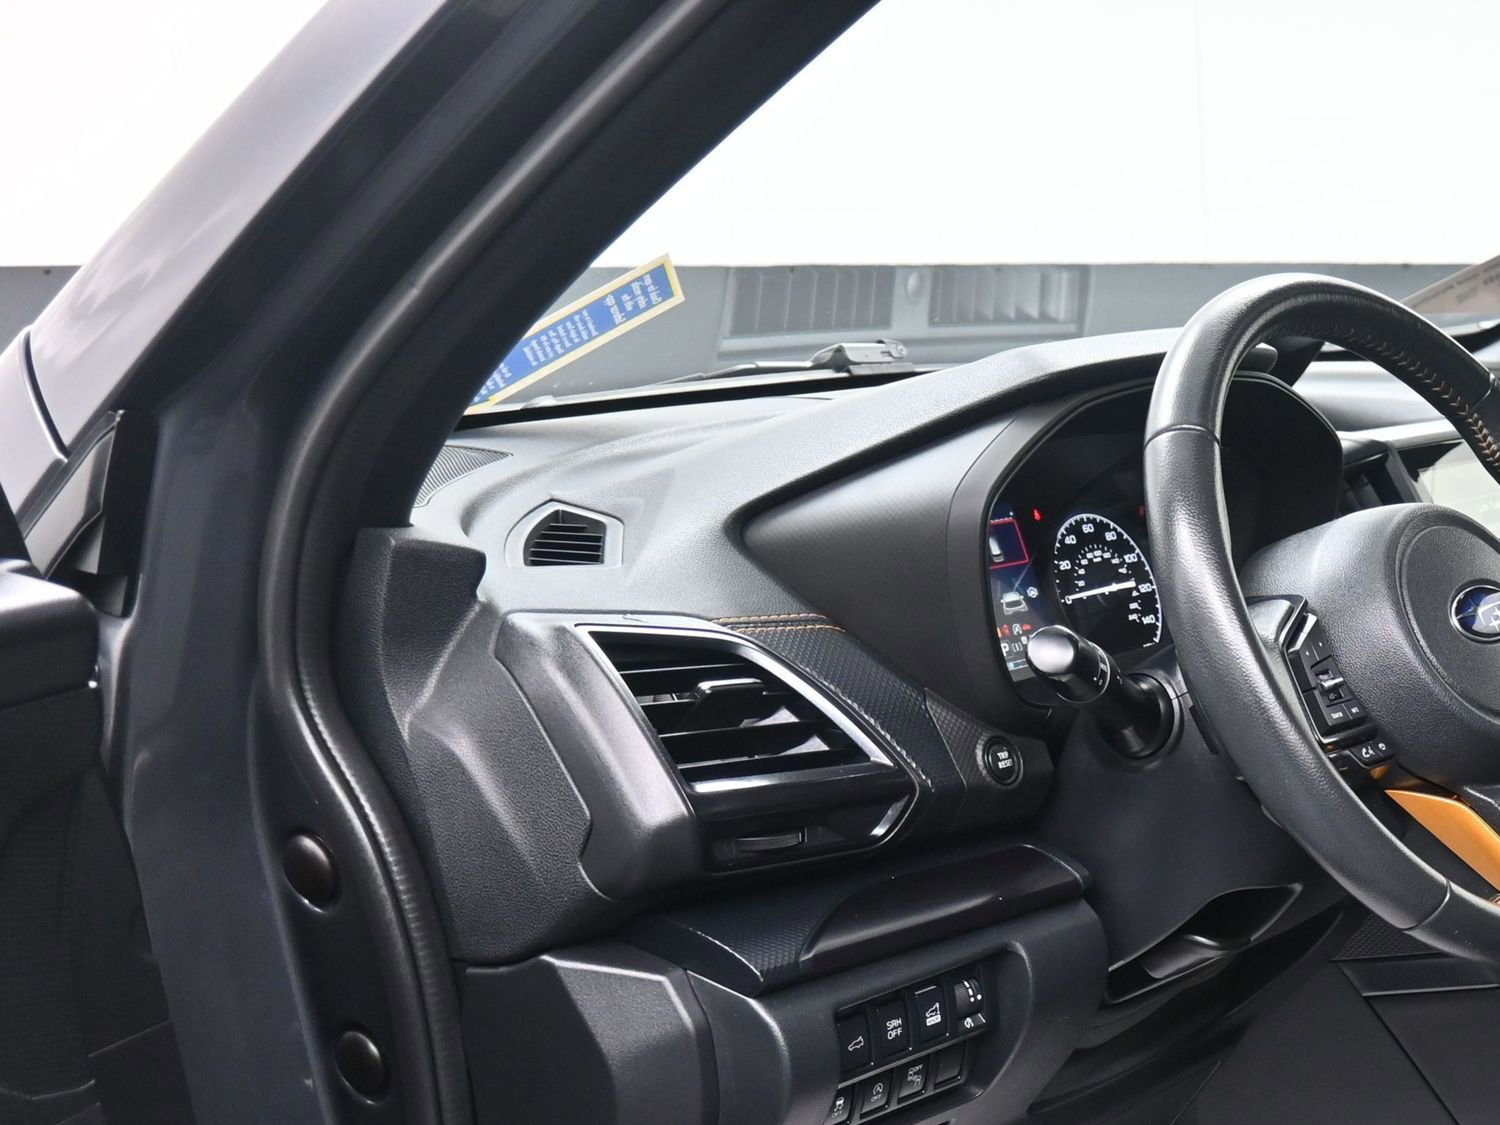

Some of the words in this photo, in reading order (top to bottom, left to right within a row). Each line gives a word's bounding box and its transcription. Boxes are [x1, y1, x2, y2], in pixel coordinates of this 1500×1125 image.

[1082, 524, 1094, 533] 60
[1064, 535, 1077, 545] 40
[1105, 531, 1117, 541] 80
[1123, 553, 1138, 563] 100
[1059, 561, 1071, 571] 20
[1138, 583, 1153, 593] 120
[1141, 615, 1156, 625] 140
[1001, 643, 1010, 656] P
[886, 1018, 902, 1031] SRH
[887, 1028, 903, 1040] OFF
